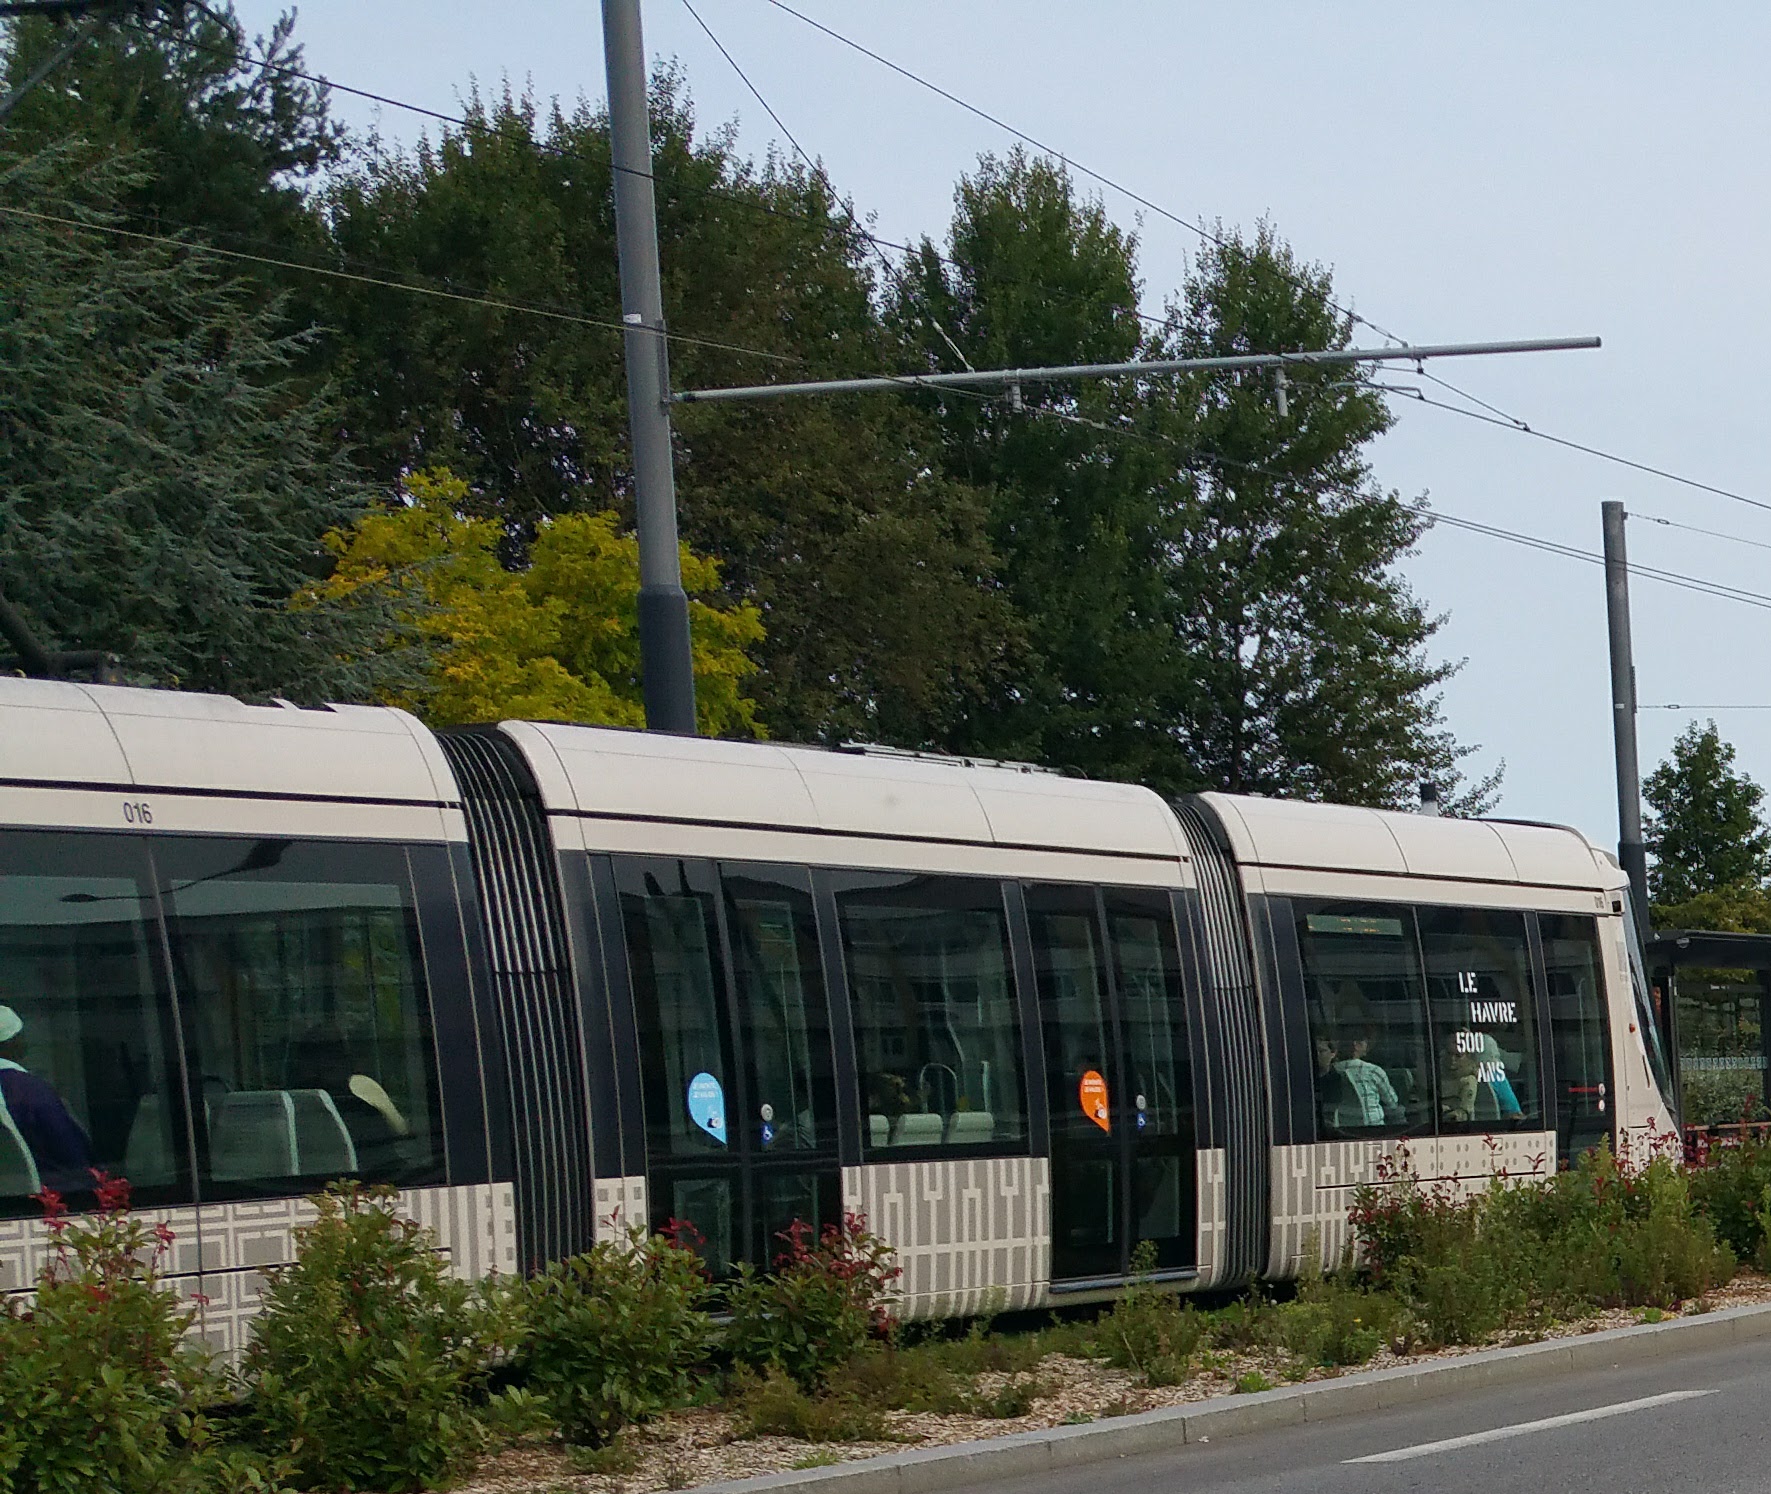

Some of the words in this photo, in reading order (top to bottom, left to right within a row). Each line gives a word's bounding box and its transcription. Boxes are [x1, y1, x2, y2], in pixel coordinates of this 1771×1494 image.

[123, 802, 153, 824] 016
[1458, 971, 1478, 993] LE
[1470, 1001, 1518, 1023] HAVRE
[1455, 1031, 1485, 1053] 500
[1477, 1061, 1506, 1083] ANS
